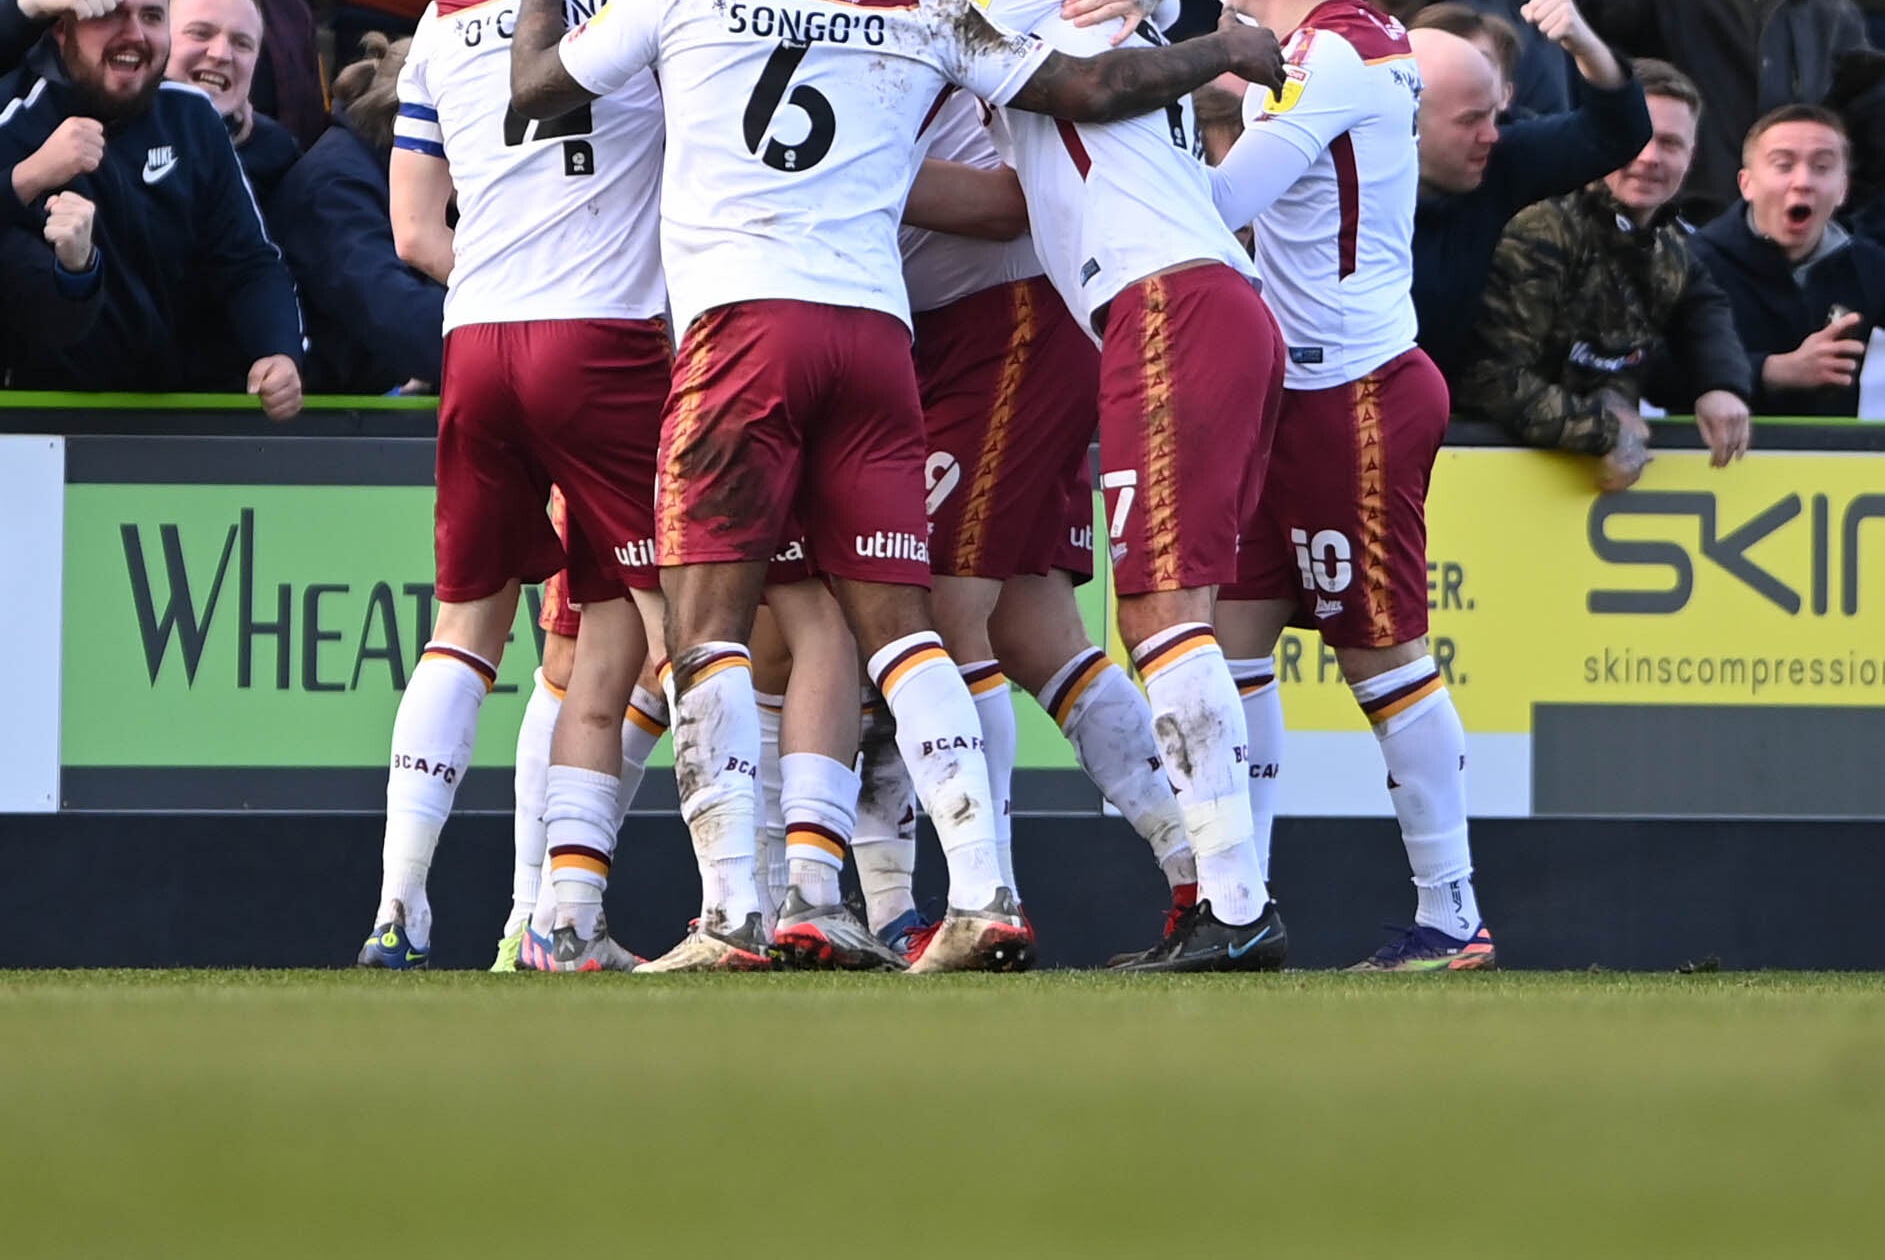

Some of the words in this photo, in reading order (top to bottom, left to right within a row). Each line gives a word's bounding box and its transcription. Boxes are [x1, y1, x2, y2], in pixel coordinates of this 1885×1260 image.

[728, 4, 885, 46] SONGO'O
[742, 40, 836, 172] 6
[147, 145, 172, 168] NIKE
[925, 451, 960, 515] 9
[1101, 469, 1137, 538] 7
[614, 538, 656, 567] util
[855, 531, 929, 564] utilita
[1291, 527, 1352, 593] 10
[119, 506, 546, 692] WHEAT
[1583, 646, 1885, 696] skinscompressio
[394, 753, 456, 784] BCAFC
[724, 755, 757, 781] BCA
